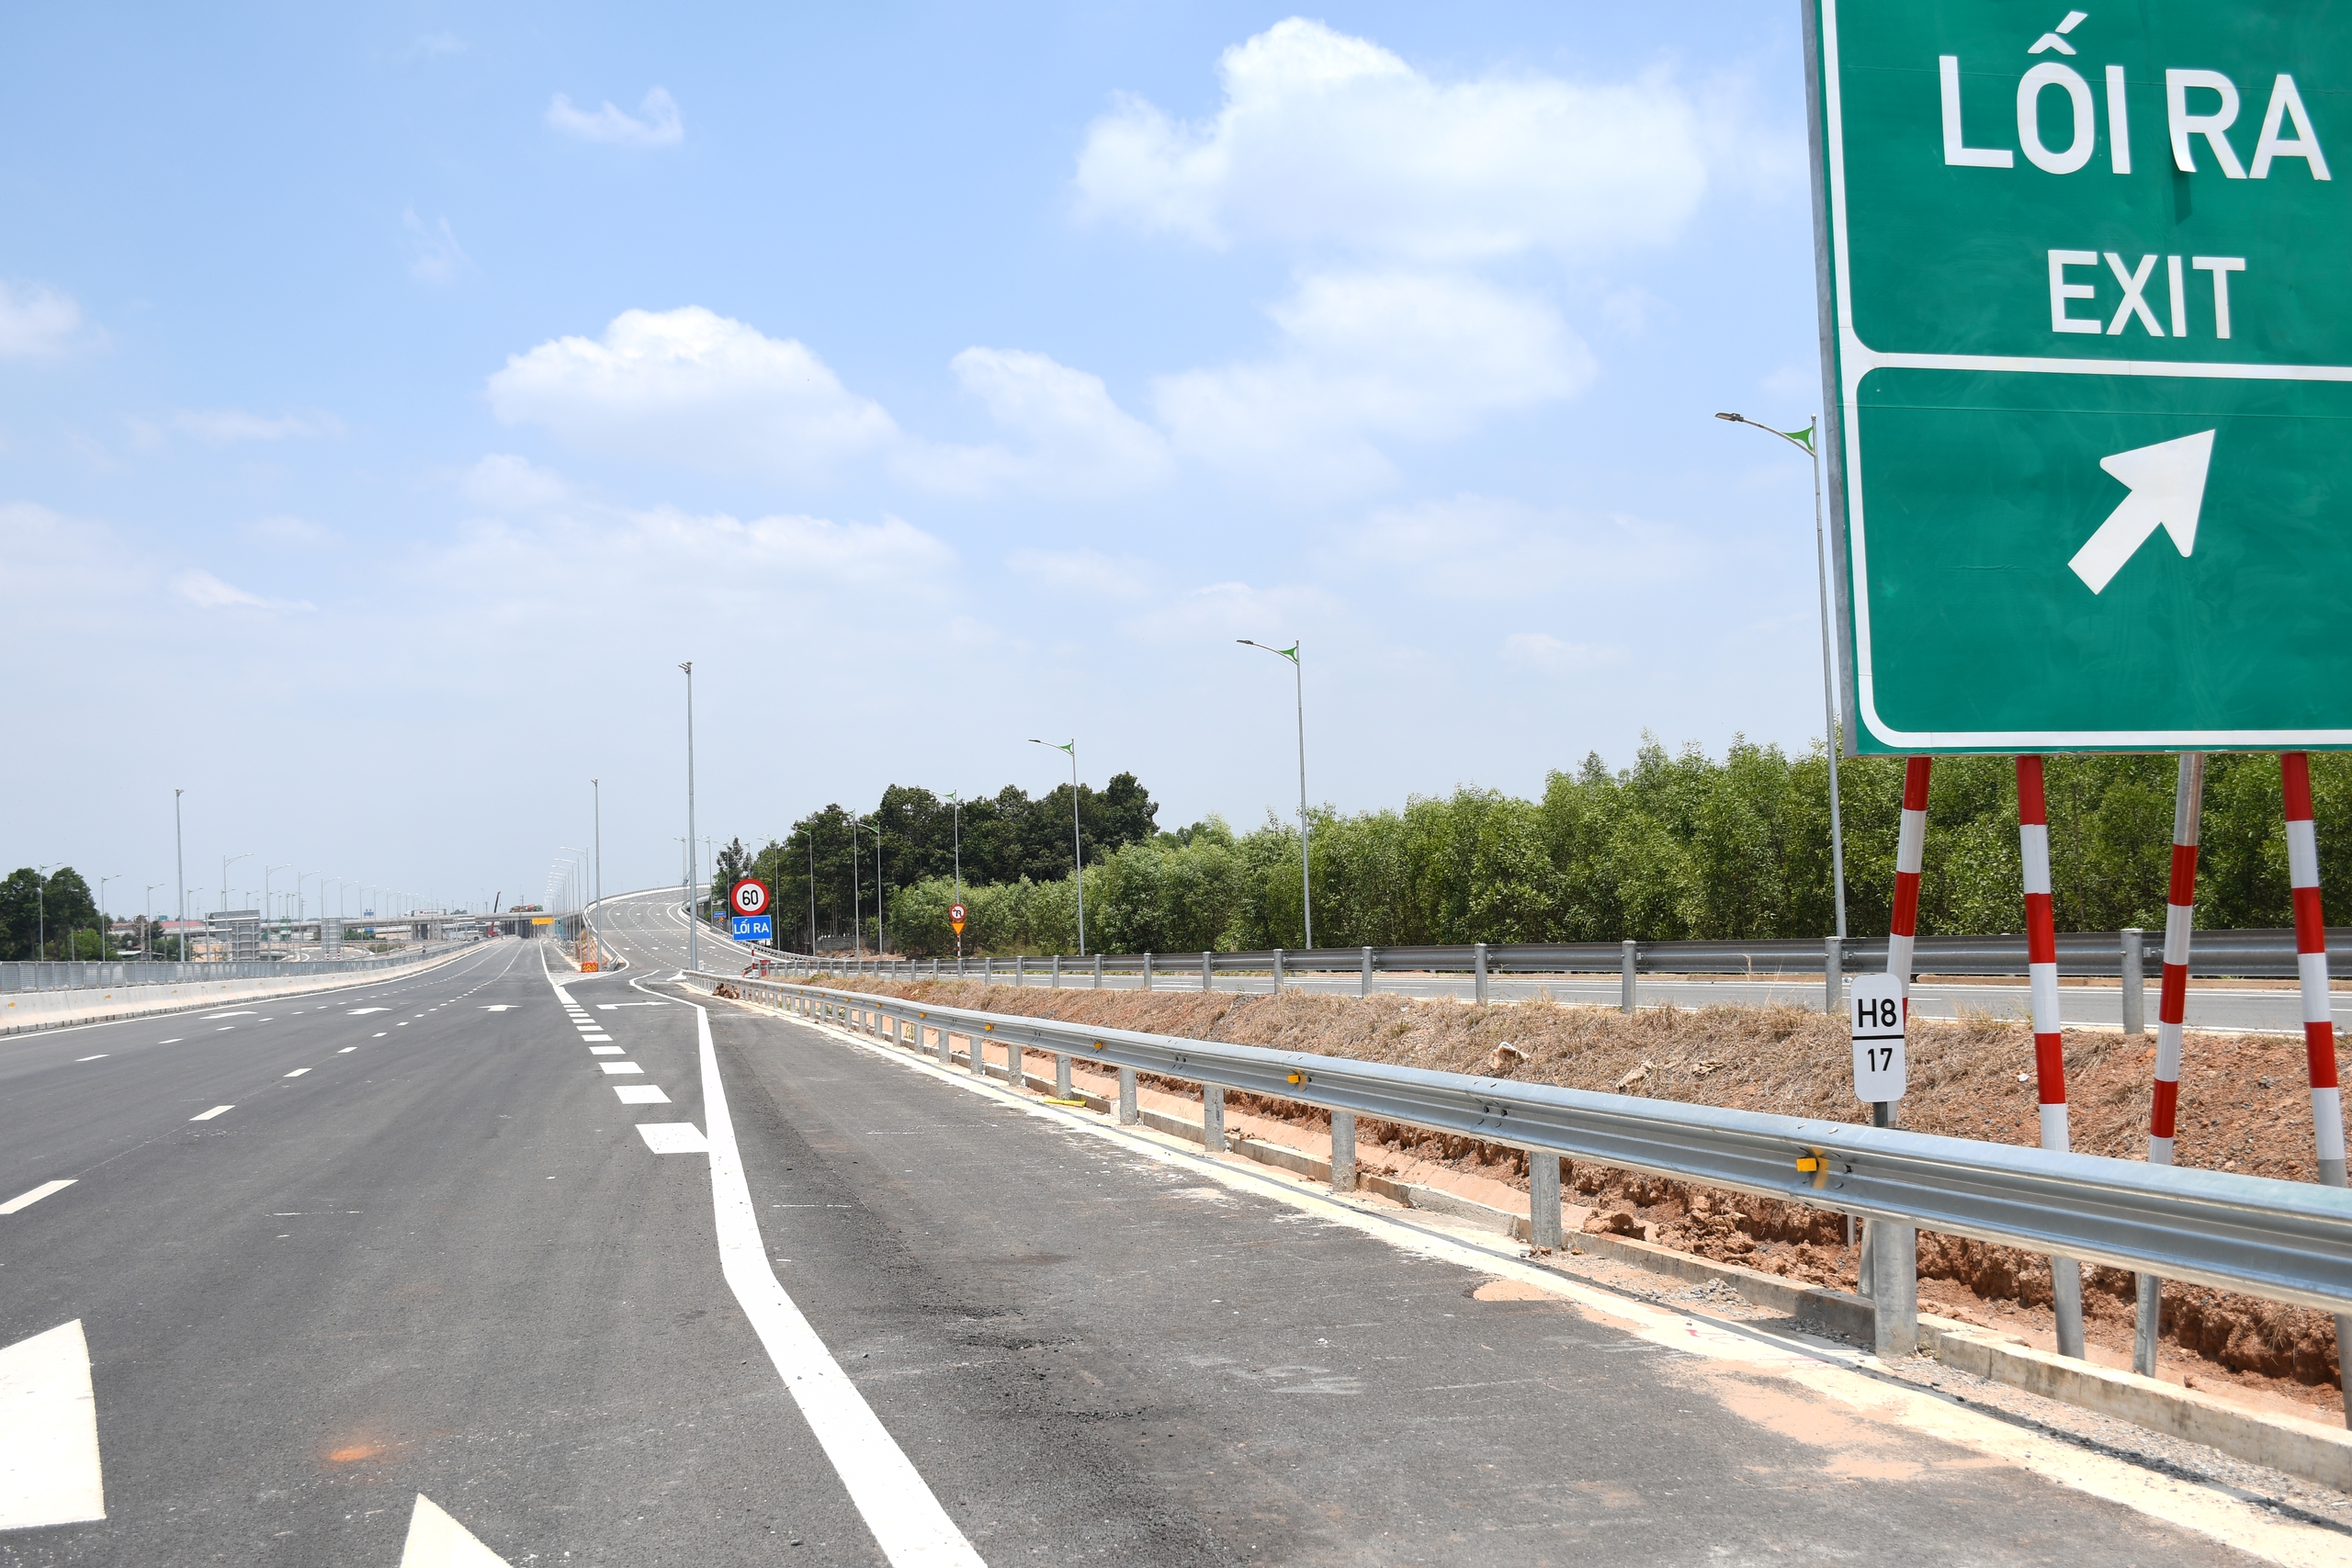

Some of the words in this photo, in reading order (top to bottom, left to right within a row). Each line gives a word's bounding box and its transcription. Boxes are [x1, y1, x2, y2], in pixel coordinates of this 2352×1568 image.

[1939, 11, 2131, 175] LỐI
[2165, 69, 2331, 180] RA
[2048, 249, 2245, 339] EXIT
[742, 890, 759, 906] 60
[734, 919, 750, 934] LỐI
[753, 922, 769, 933] RA
[1858, 998, 1896, 1027] H8
[1868, 1048, 1893, 1072] 17
